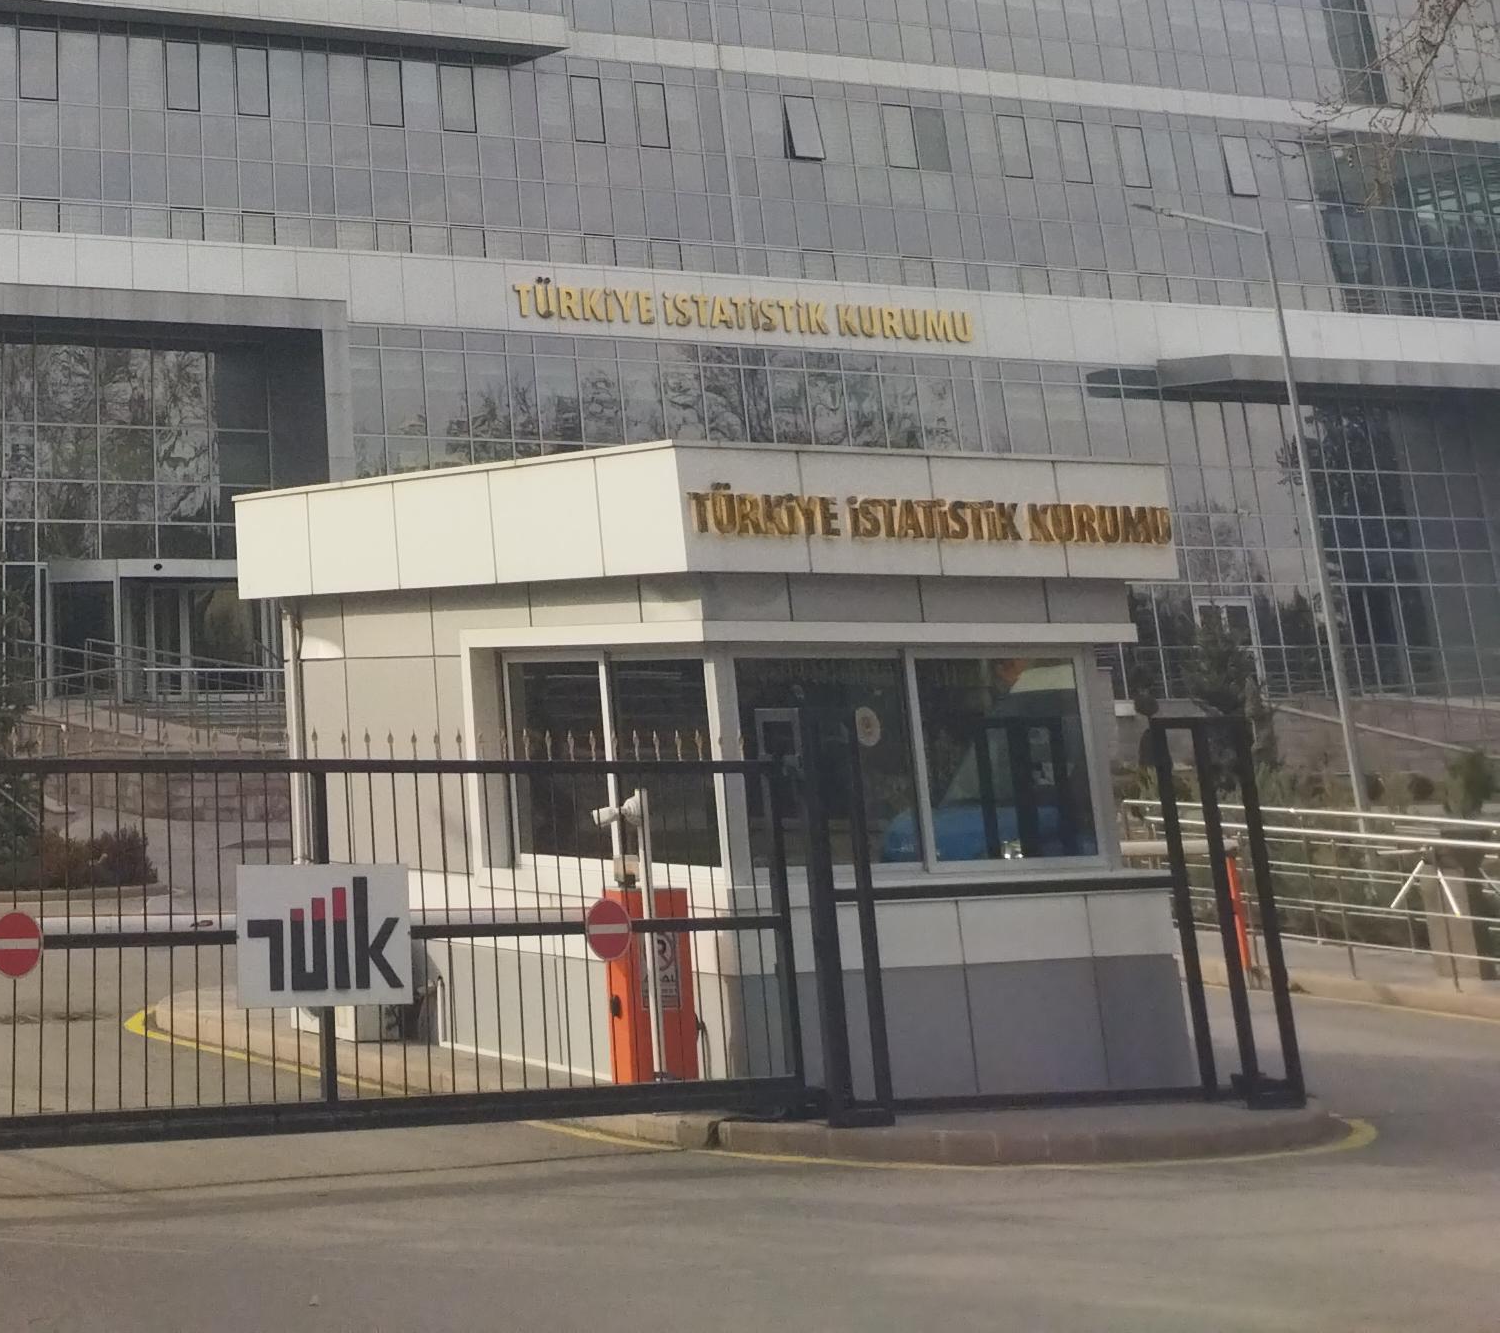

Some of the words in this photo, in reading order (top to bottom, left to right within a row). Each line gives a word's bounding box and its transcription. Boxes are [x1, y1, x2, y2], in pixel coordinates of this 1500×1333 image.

[513, 276, 654, 325] TÜRKİYE
[663, 292, 830, 335] İSTATİSTİK
[835, 303, 974, 343] KURUMU
[686, 482, 841, 537] TÜRKİYE
[846, 494, 1023, 541] İSTATİSTİK
[1026, 502, 1174, 545] KURUMU
